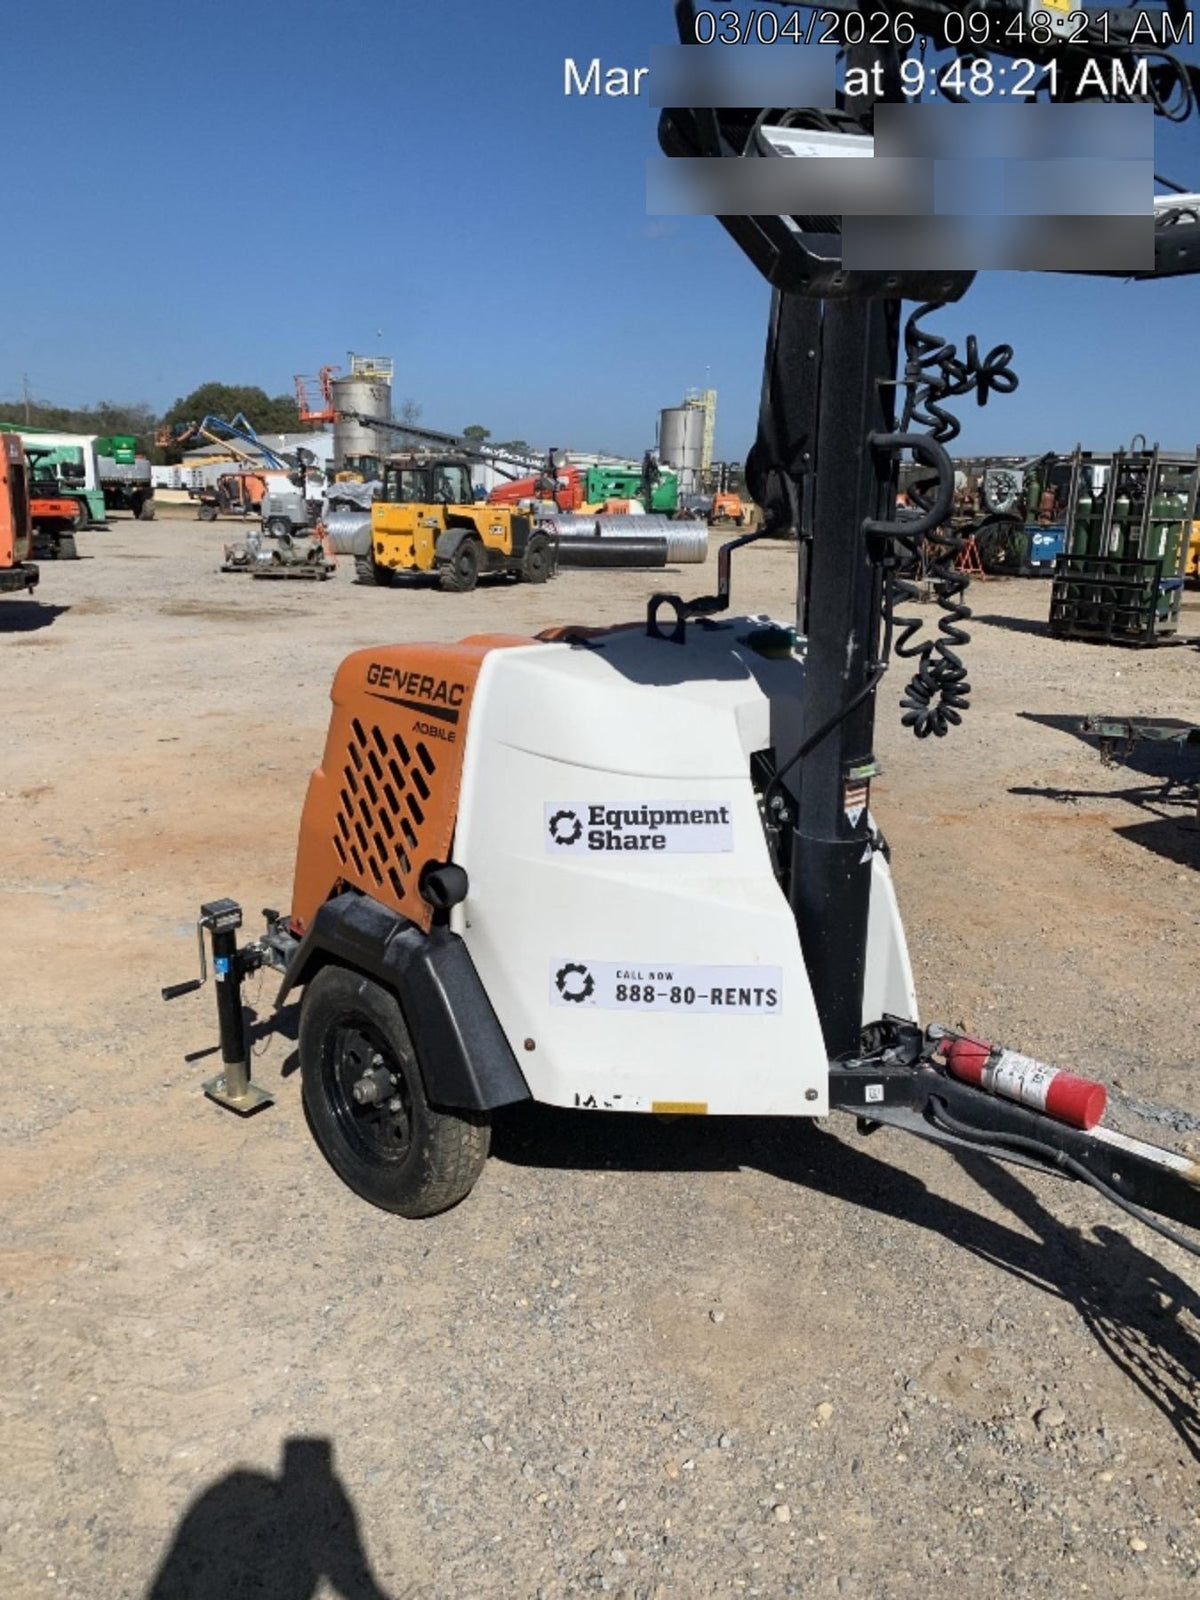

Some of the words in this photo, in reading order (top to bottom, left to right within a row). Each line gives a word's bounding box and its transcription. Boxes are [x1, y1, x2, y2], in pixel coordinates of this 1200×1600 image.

[366, 662, 466, 707] GENERAC
[588, 805, 730, 830] Equipment
[588, 830, 667, 850] Share
[616, 969, 645, 981] CALL
[648, 971, 674, 981] NOW
[615, 983, 778, 1007] 888-80-RENTS
